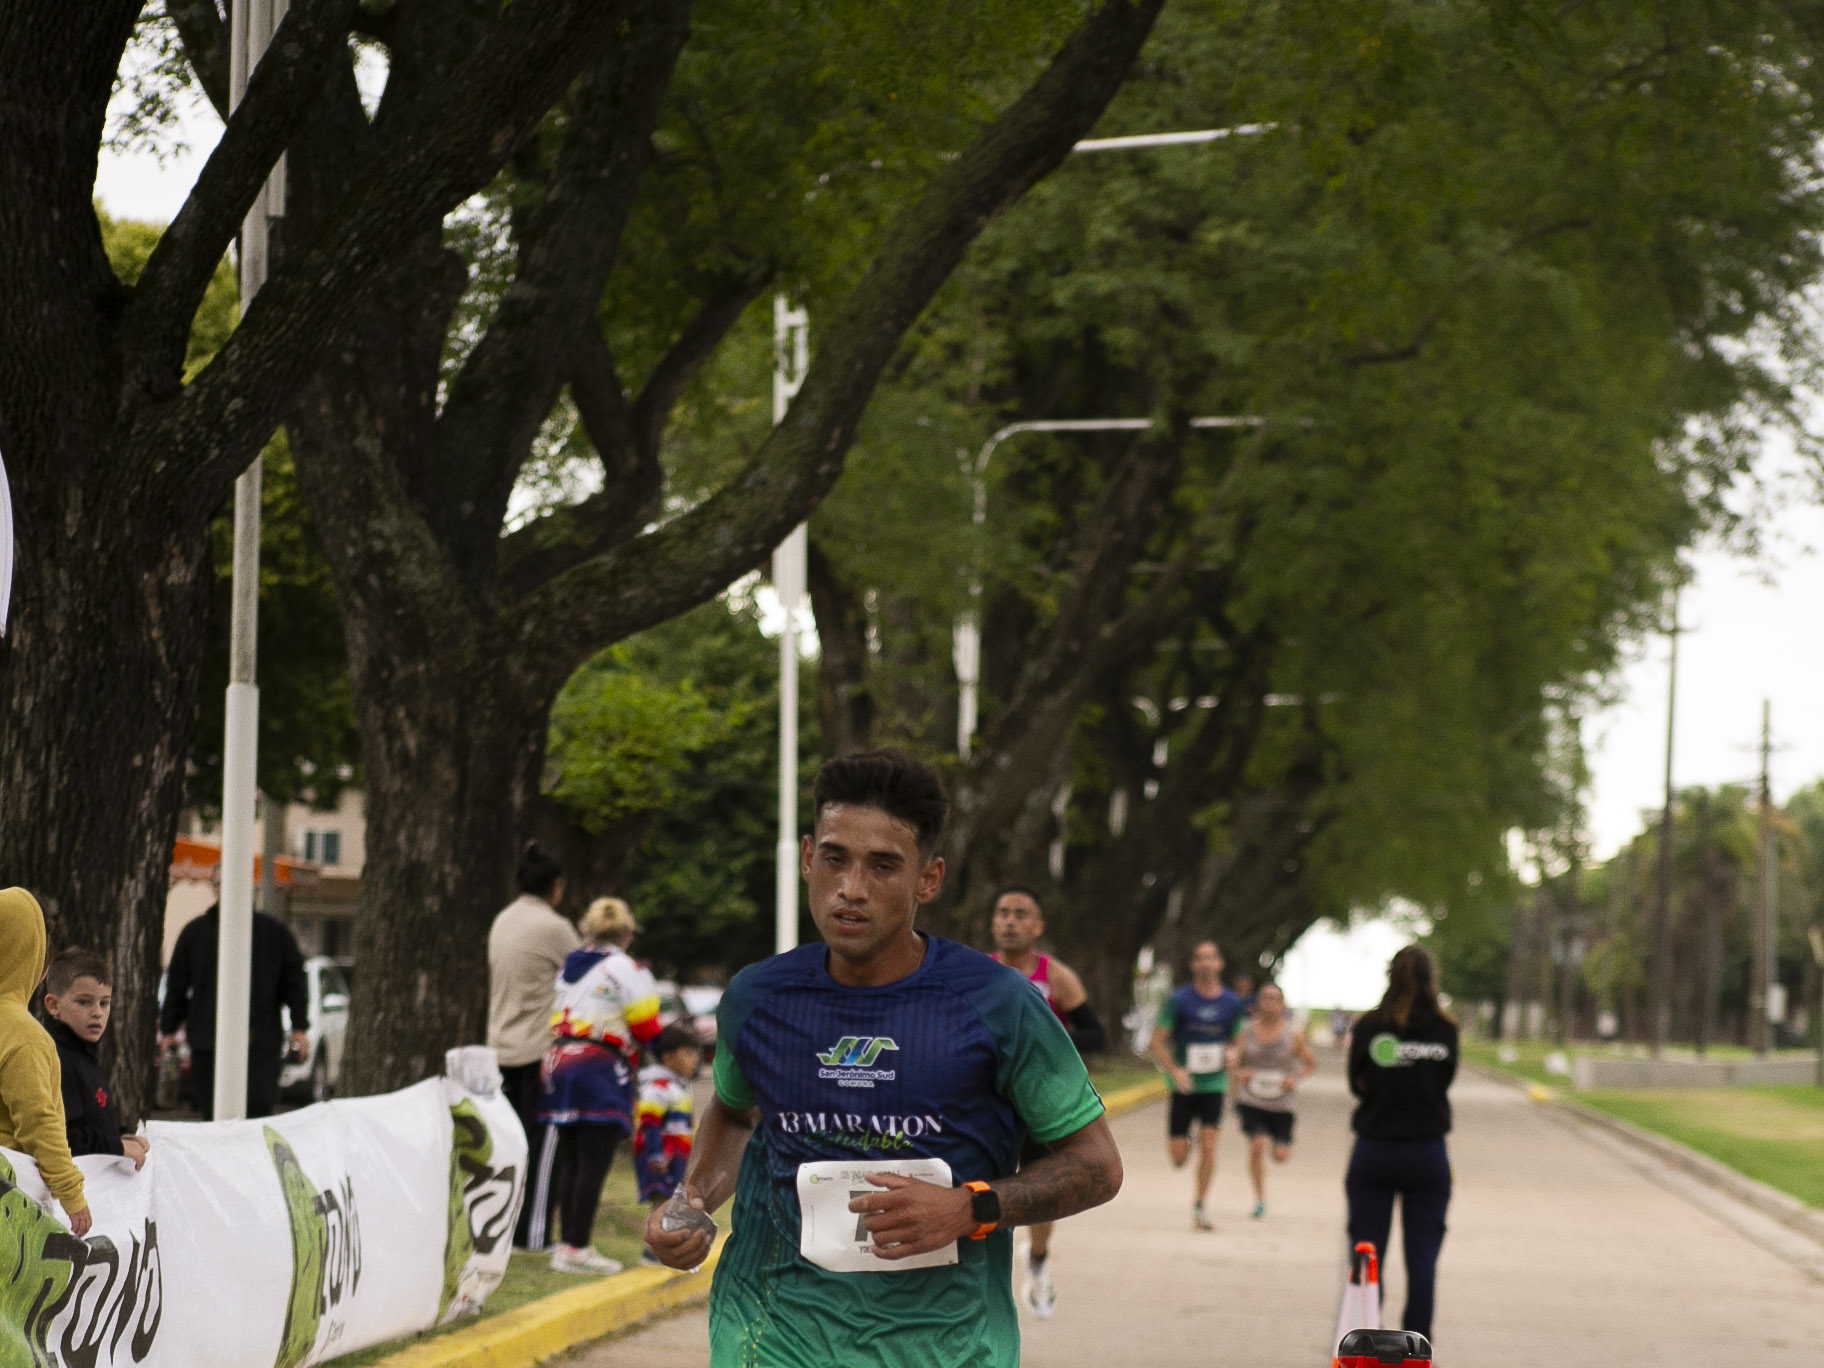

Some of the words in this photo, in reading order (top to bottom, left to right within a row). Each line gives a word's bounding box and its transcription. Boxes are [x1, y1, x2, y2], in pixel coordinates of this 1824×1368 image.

[819, 1069, 836, 1078] San
[877, 1070, 895, 1080] Sud
[805, 1112, 943, 1137] MARATON
